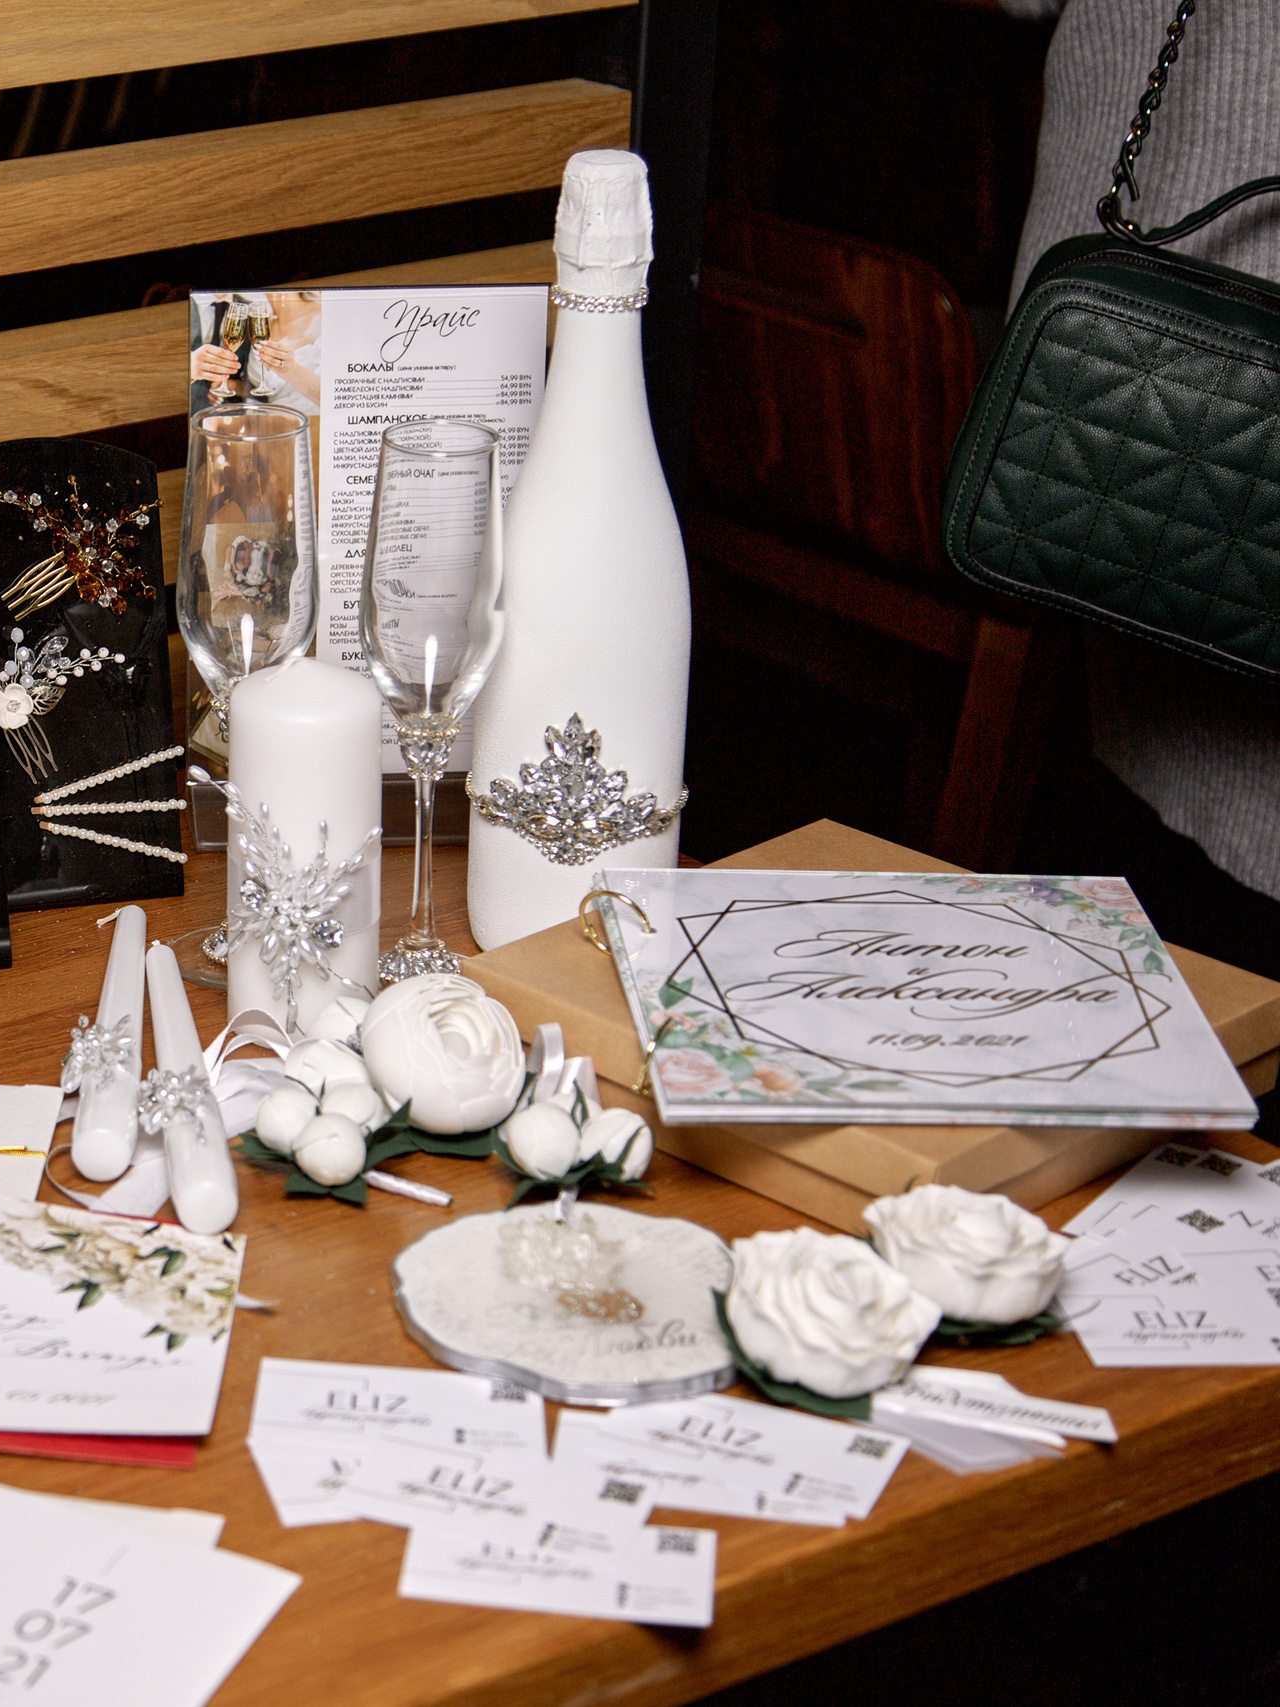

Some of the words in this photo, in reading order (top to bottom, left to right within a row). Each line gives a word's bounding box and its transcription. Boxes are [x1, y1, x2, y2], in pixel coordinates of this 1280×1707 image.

[380, 299, 481, 363] Прайс
[348, 362, 394, 373] БОКАЛЫ
[774, 928, 1032, 959] Антон
[724, 968, 1174, 1020] Александра
[866, 1033, 1030, 1051] 11.09.2021
[1114, 1256, 1184, 1286] ELIZ
[1134, 1311, 1218, 1329] ELIZ
[327, 1390, 410, 1414] ELIZ
[678, 1415, 764, 1450] ELIZ
[428, 1465, 515, 1498] ELIZ
[52, 1575, 118, 1614] 17
[14, 1608, 92, 1650] 07
